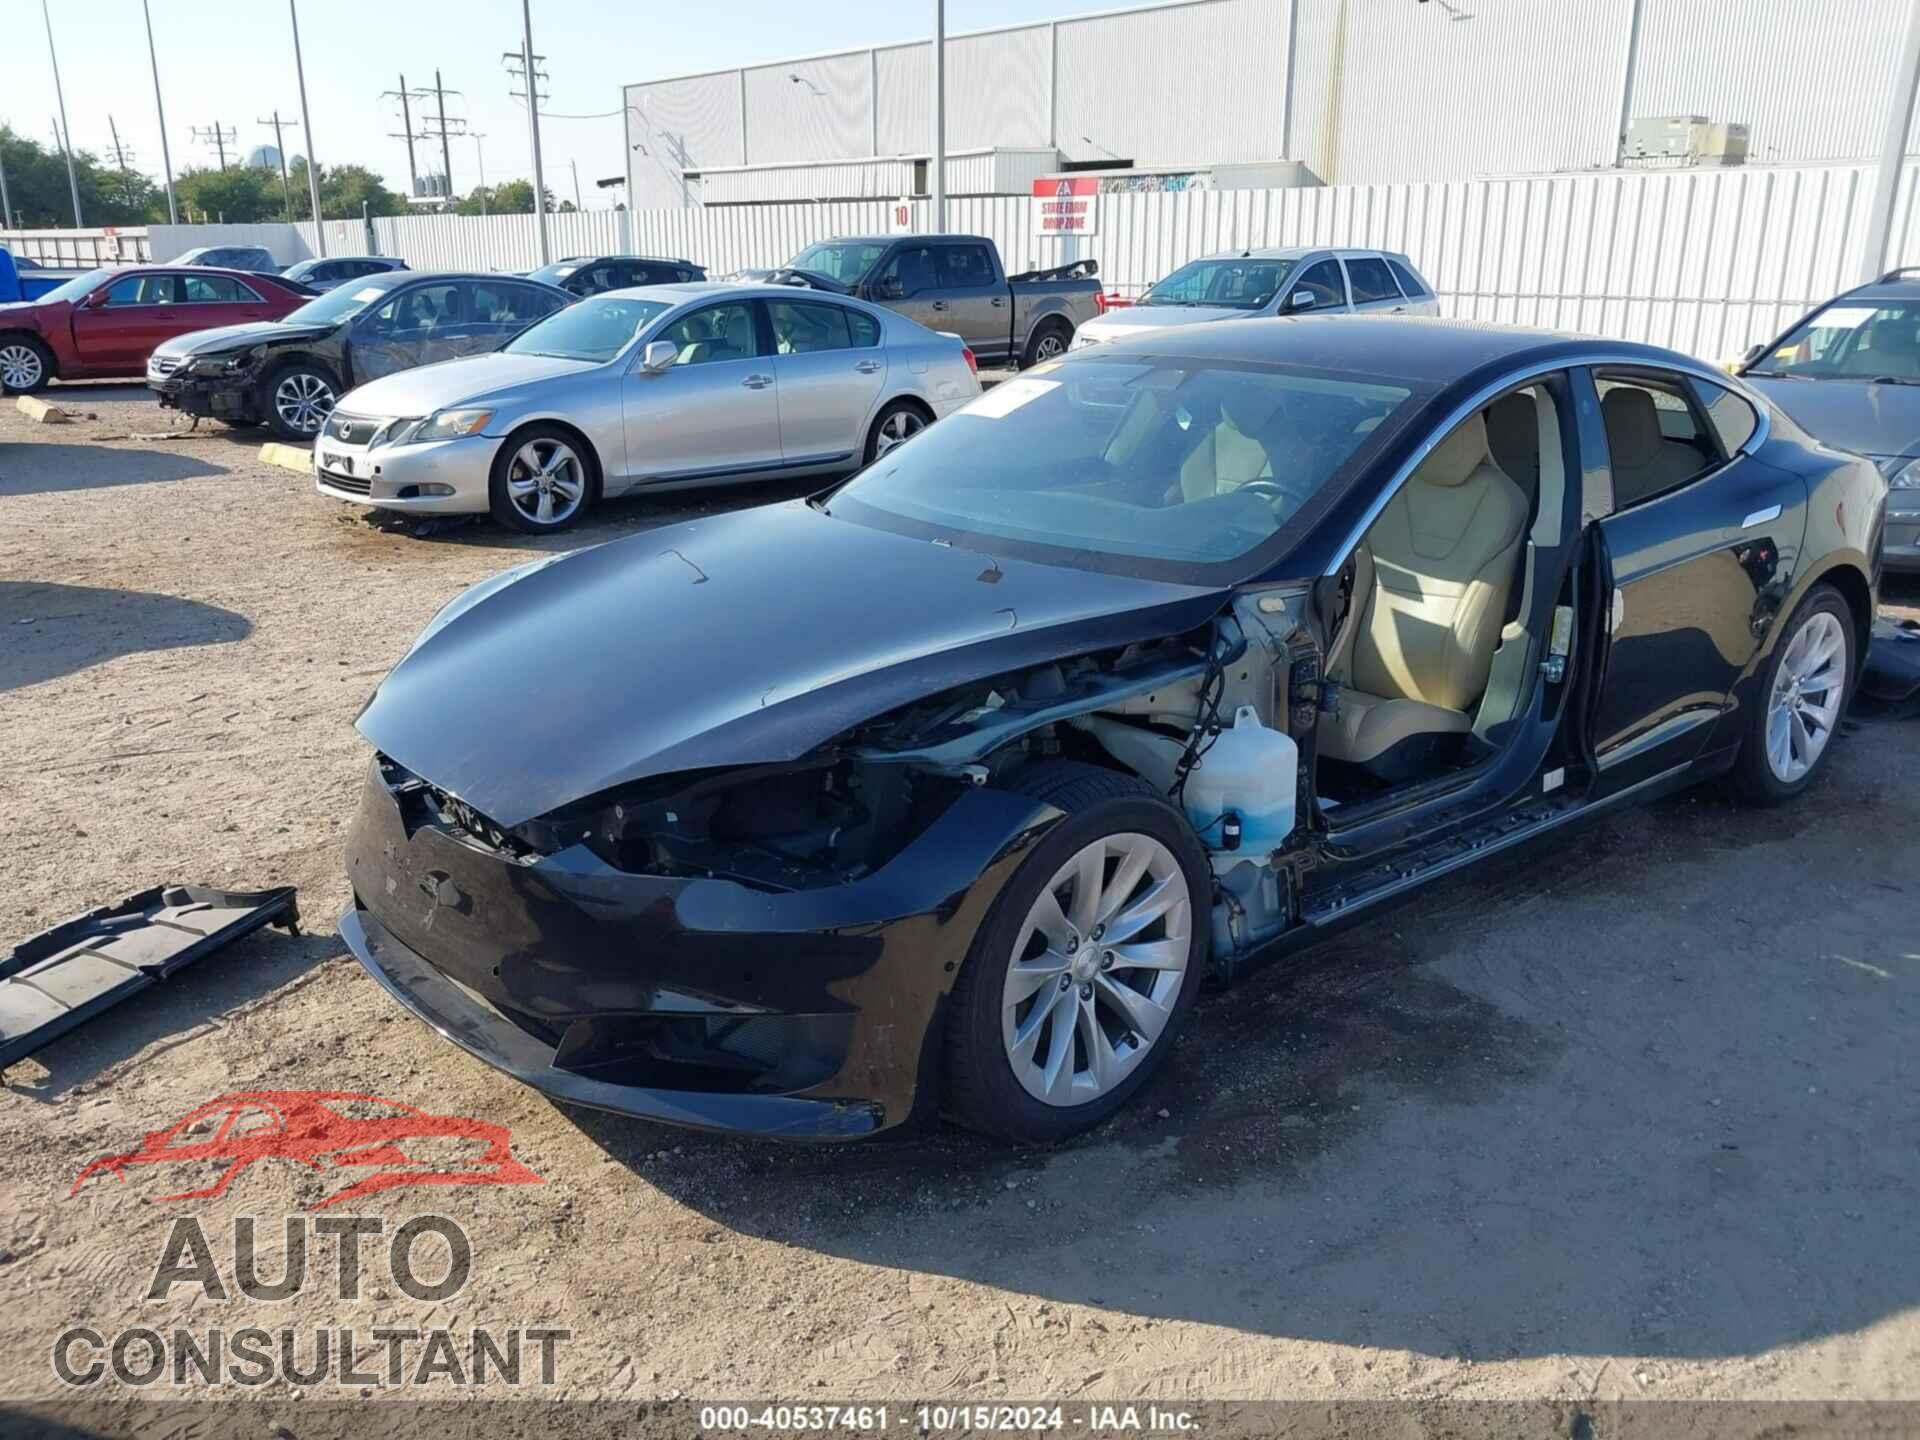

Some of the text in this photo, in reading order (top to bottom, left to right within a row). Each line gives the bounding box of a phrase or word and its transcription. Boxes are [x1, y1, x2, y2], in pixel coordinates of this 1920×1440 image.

[1041, 201, 1088, 215] STATE FARM
[895, 206, 908, 226] 10
[1042, 216, 1085, 230] DROP ZONE
